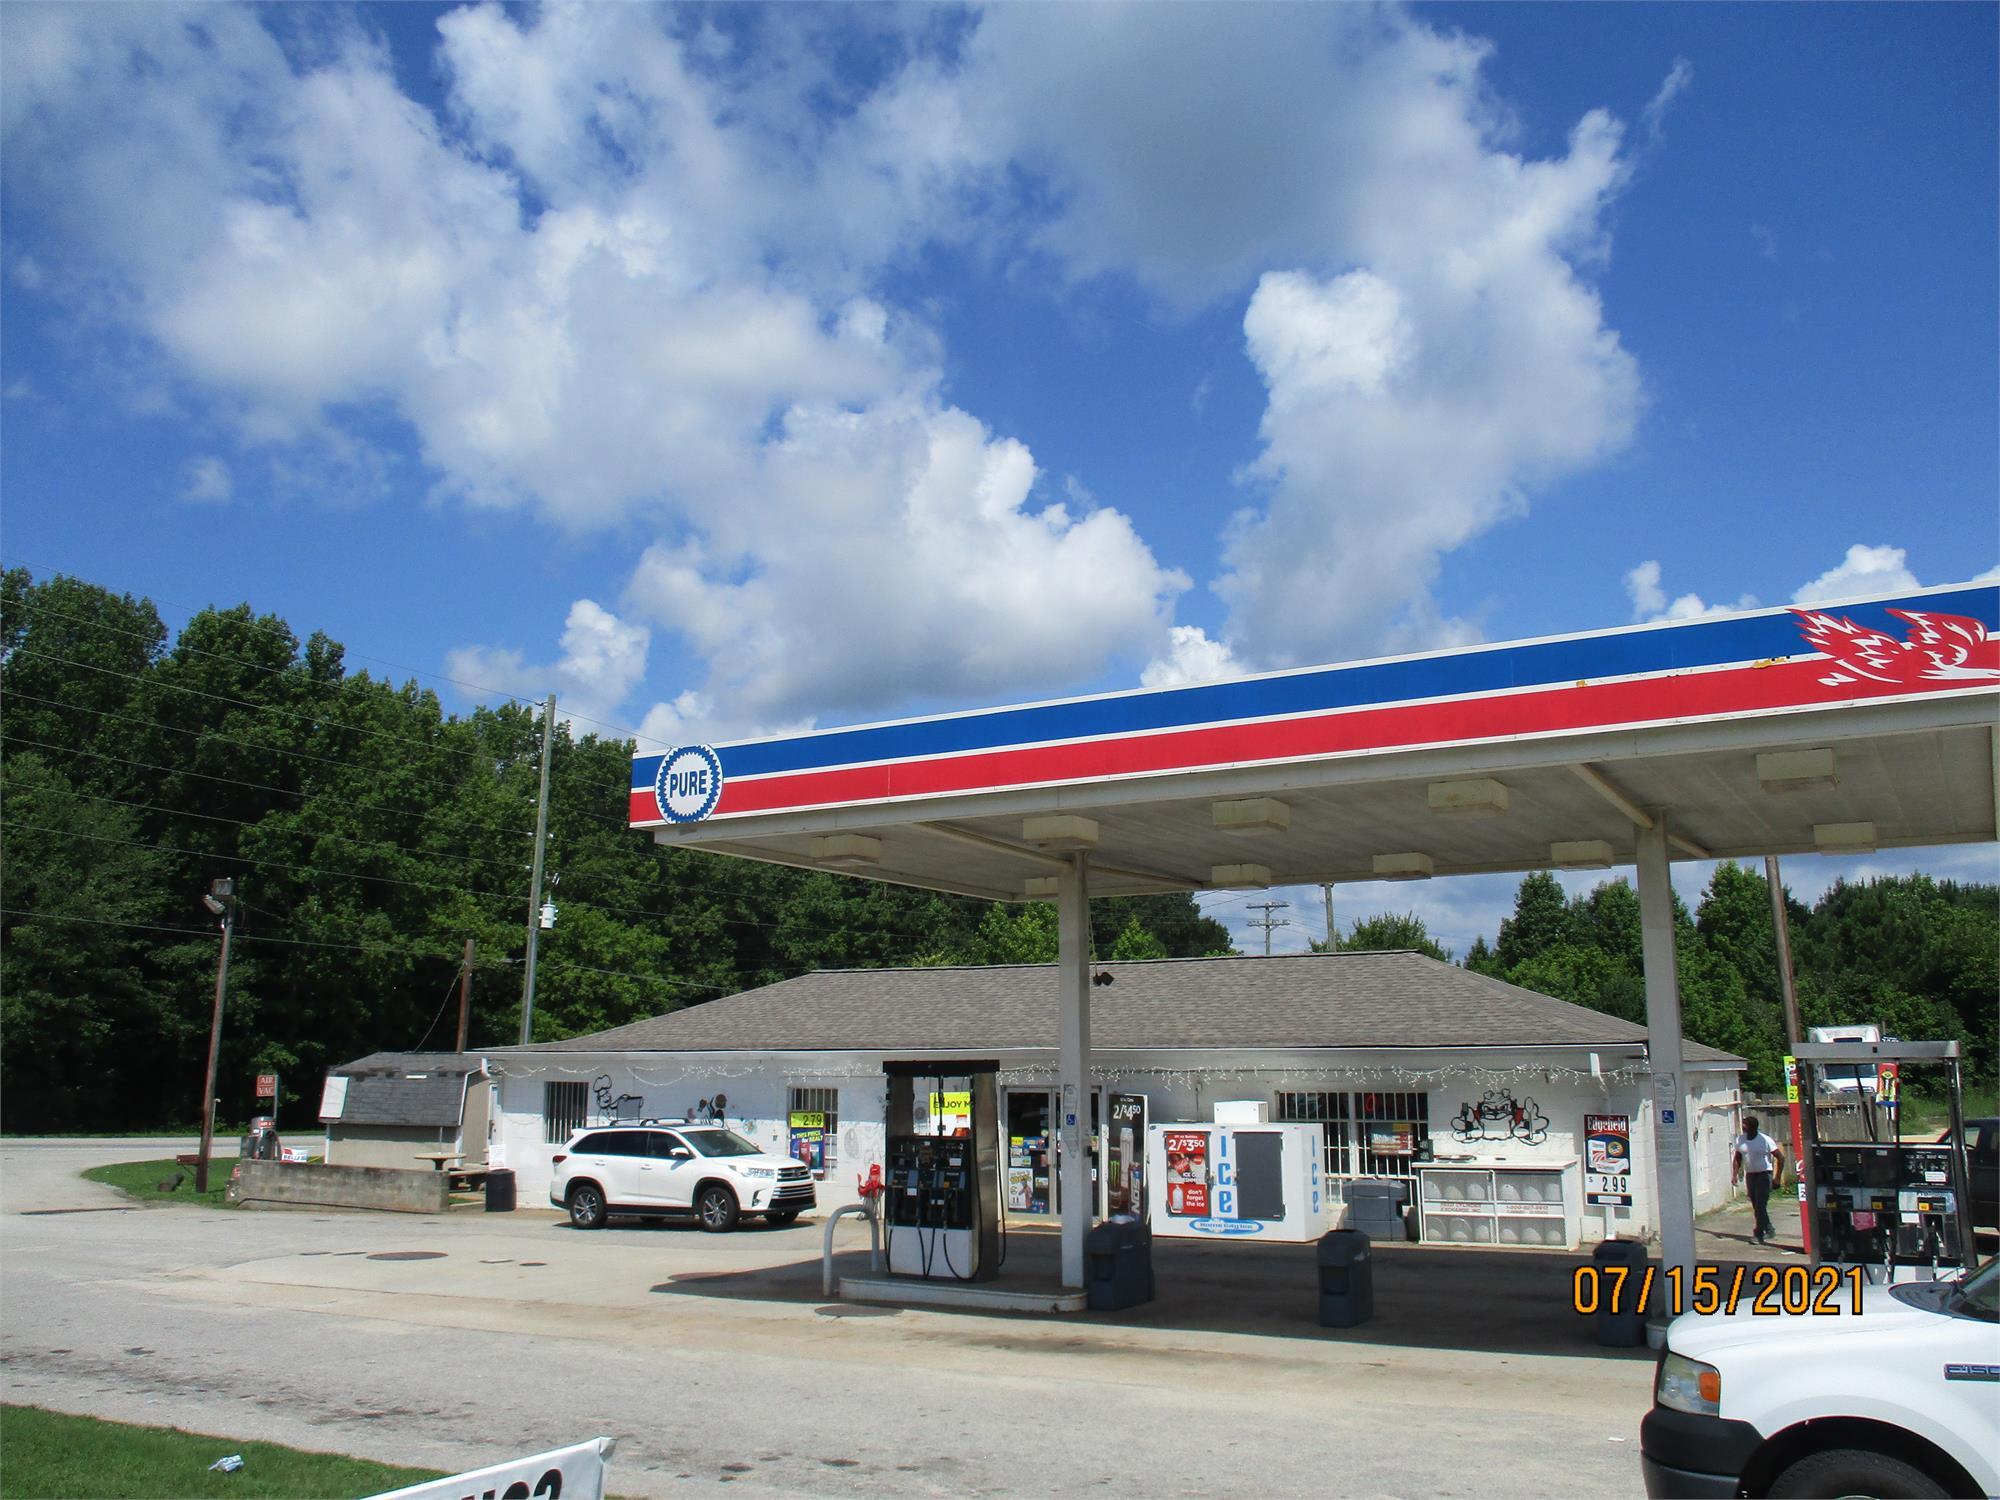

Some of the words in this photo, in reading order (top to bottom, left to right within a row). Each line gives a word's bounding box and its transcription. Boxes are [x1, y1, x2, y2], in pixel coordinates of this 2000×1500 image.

[669, 769, 708, 798] PURE
[260, 1076, 274, 1085] AIR
[258, 1087, 275, 1096] VAC
[933, 1100, 962, 1109] EJOY
[1587, 1115, 1627, 1132] Edgefield
[1602, 1176, 1627, 1192] 2.99
